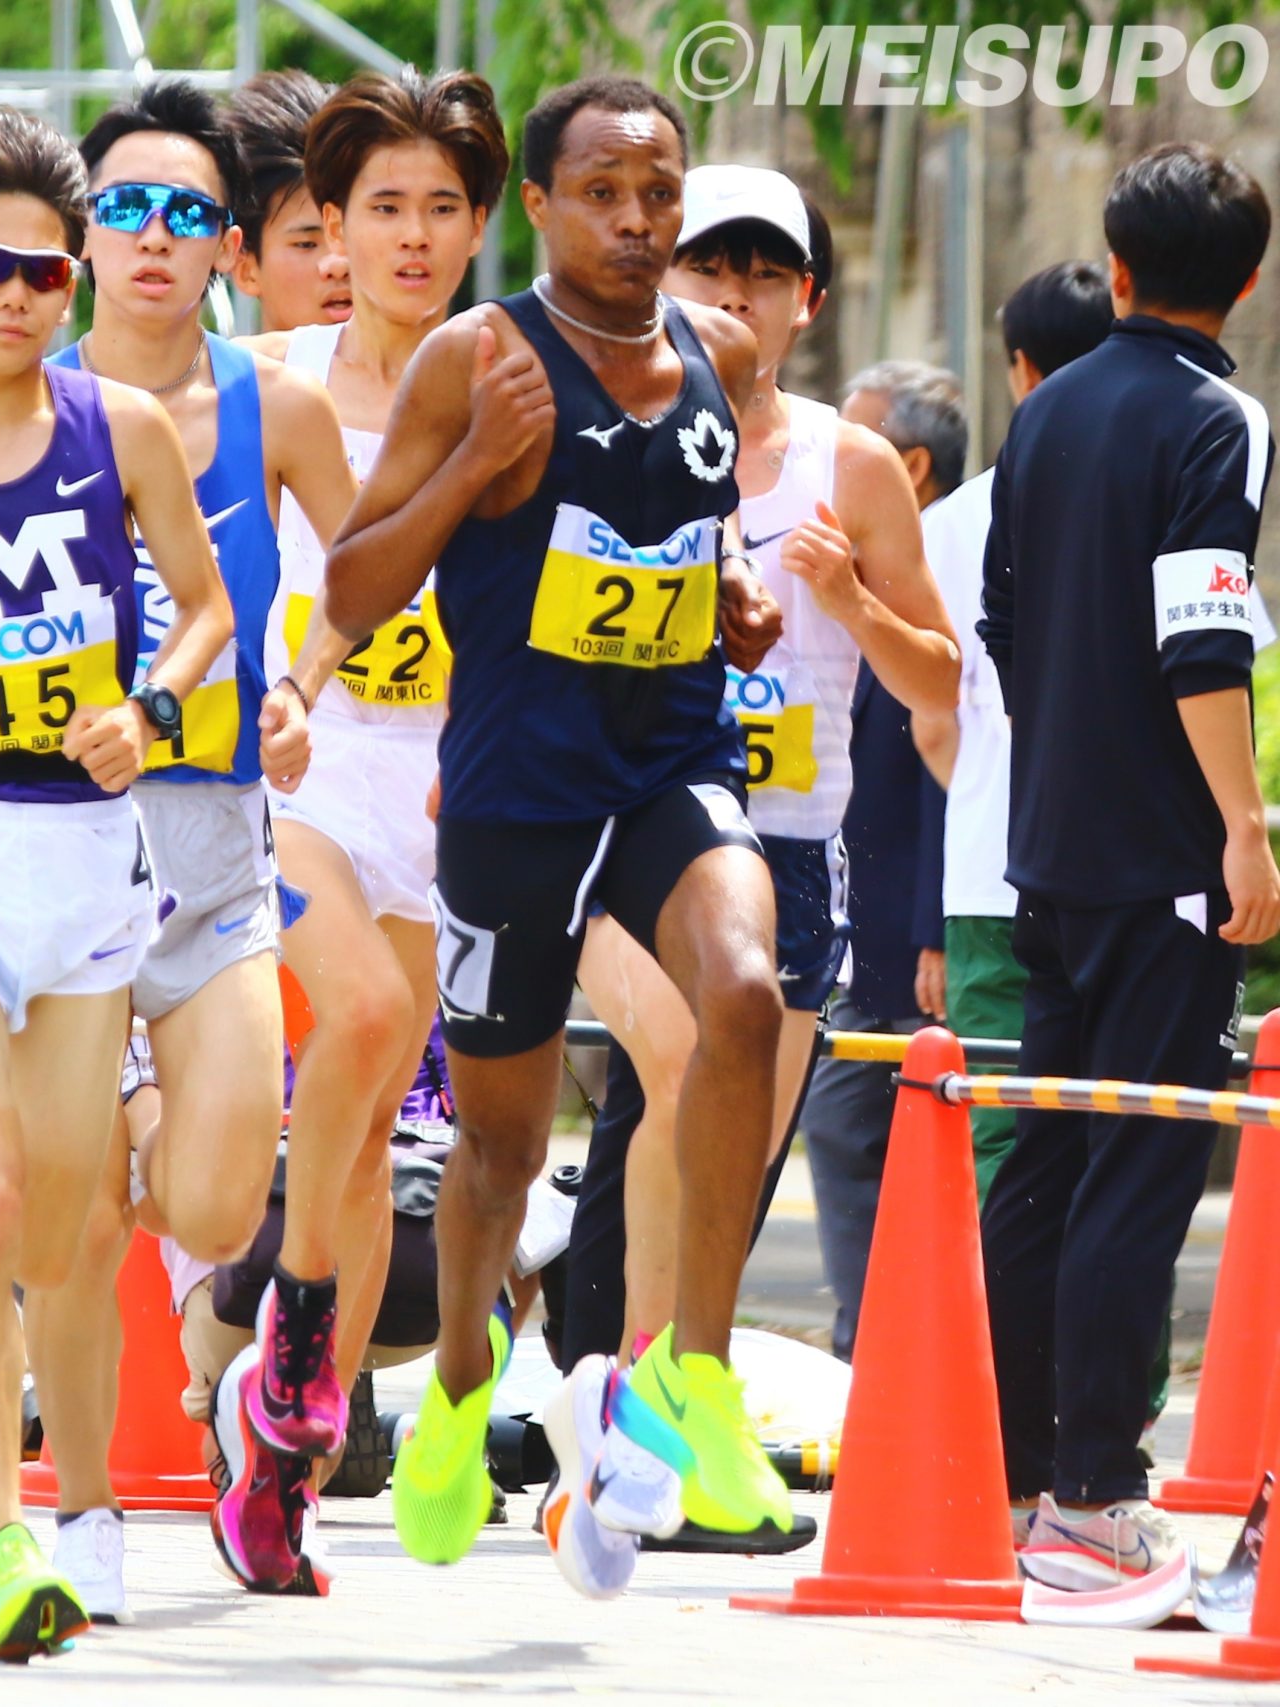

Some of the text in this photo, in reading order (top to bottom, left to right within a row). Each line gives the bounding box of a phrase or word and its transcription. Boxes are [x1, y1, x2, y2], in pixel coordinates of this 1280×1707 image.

[586, 575, 685, 641] 27
[337, 625, 431, 682] 22
[571, 637, 624, 657] 103回
[375, 682, 432, 701] 関東IC
[433, 897, 476, 991] 7
